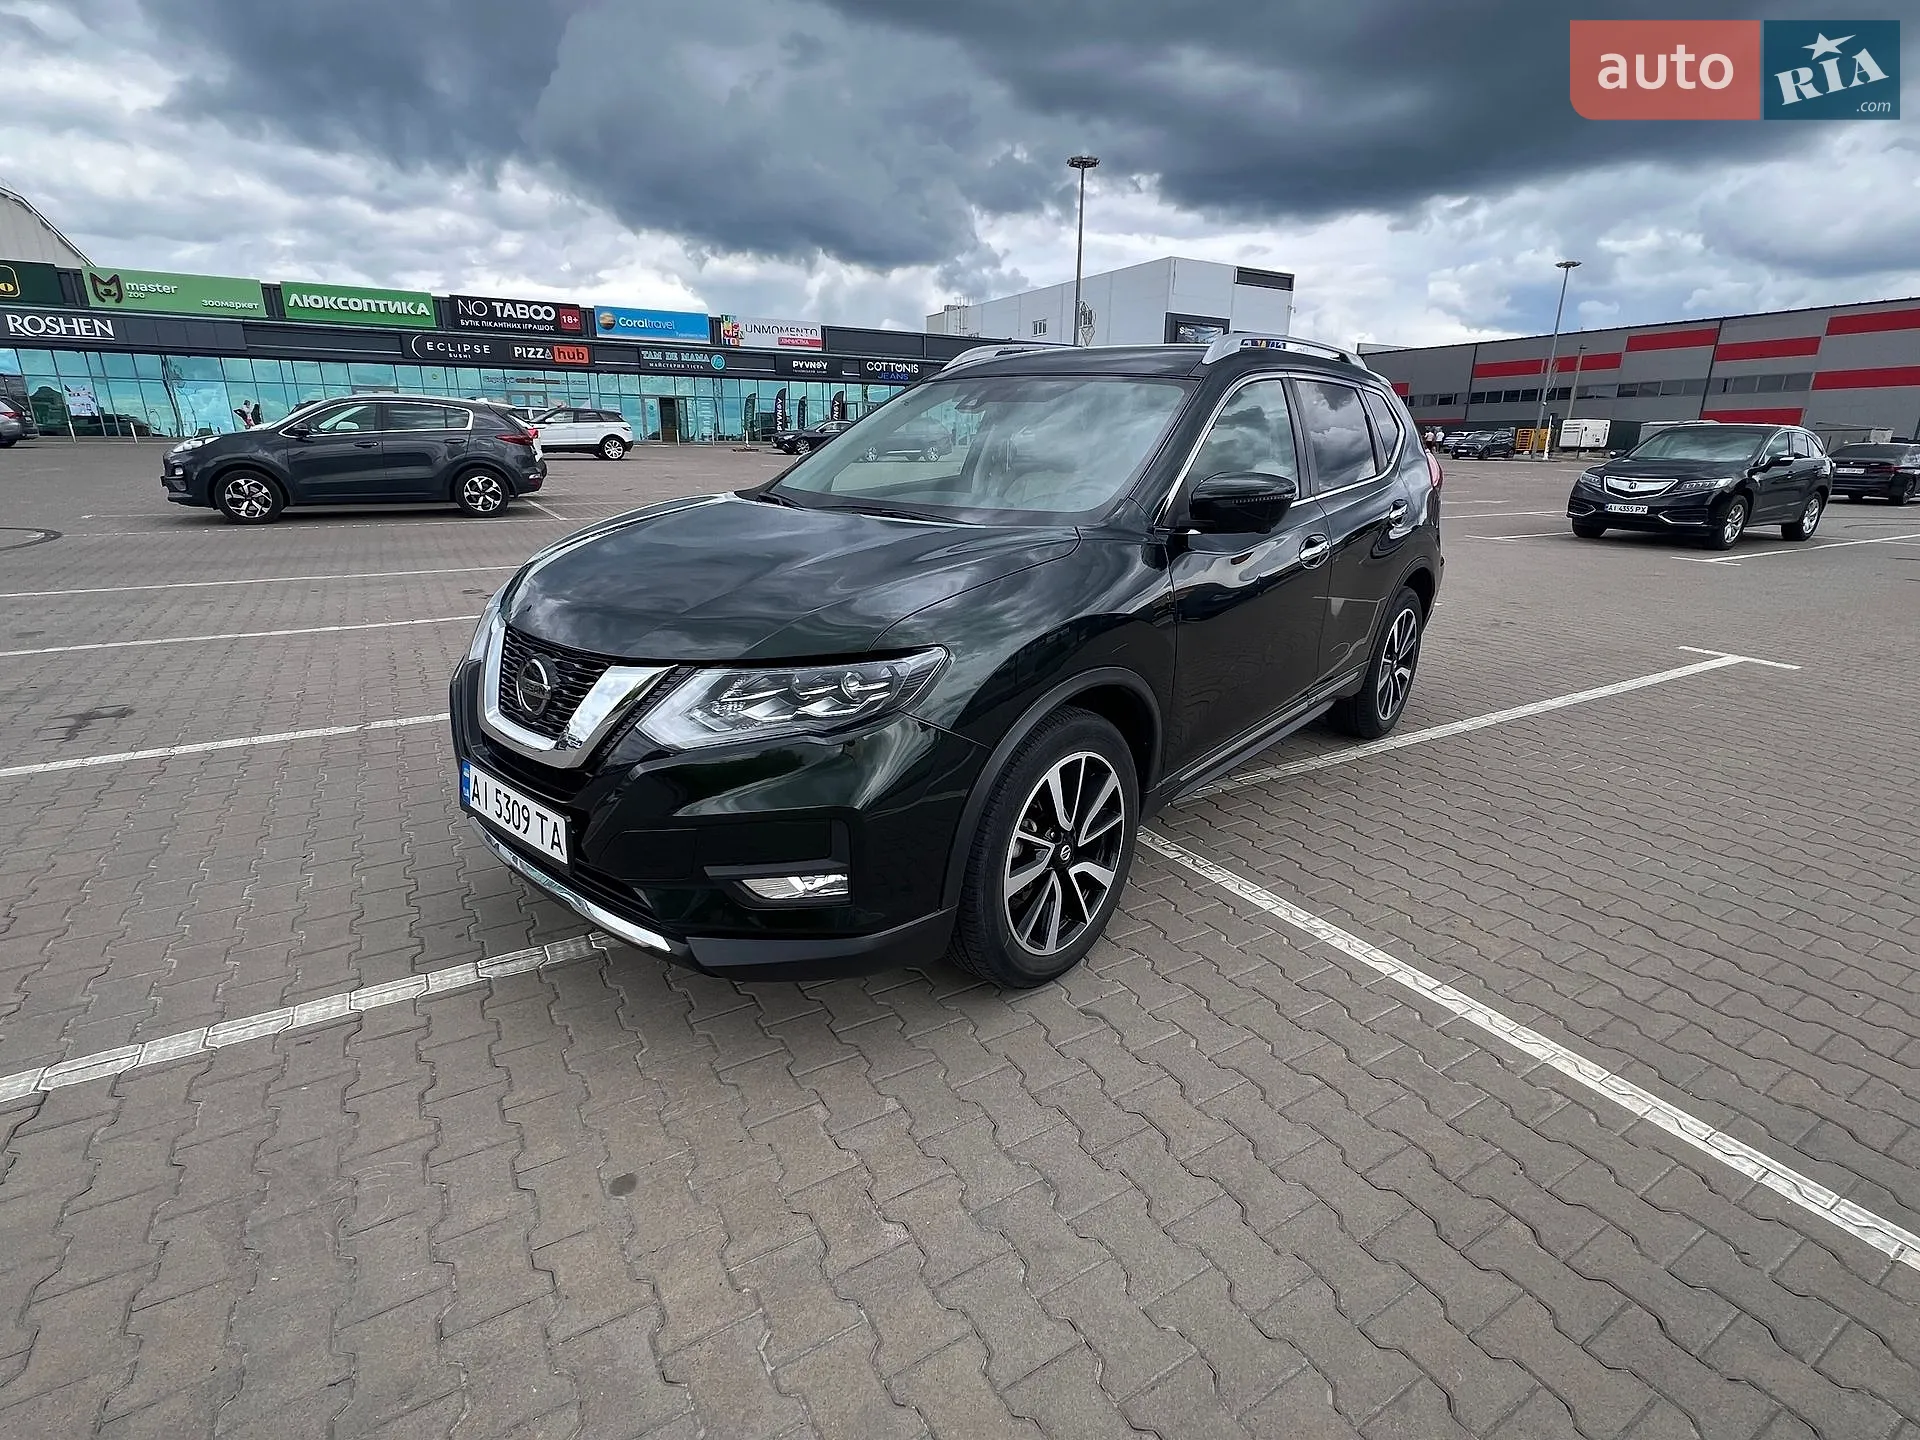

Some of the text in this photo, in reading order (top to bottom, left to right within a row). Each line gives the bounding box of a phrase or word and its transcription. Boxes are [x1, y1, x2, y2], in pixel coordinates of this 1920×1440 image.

[125, 281, 178, 294] master
[128, 291, 145, 299] zoo
[288, 293, 431, 316] ЛЮКСОПТИКА
[457, 299, 556, 321] NO TABOO
[561, 315, 579, 324] 18+
[5, 314, 115, 340] ROSHEN
[426, 341, 491, 354] ECLIPSE
[557, 349, 585, 361] hub
[641, 350, 663, 360] TAM
[681, 352, 710, 363] MAMA
[877, 372, 909, 380] JEANS
[472, 774, 564, 856] AI 5309 TA
